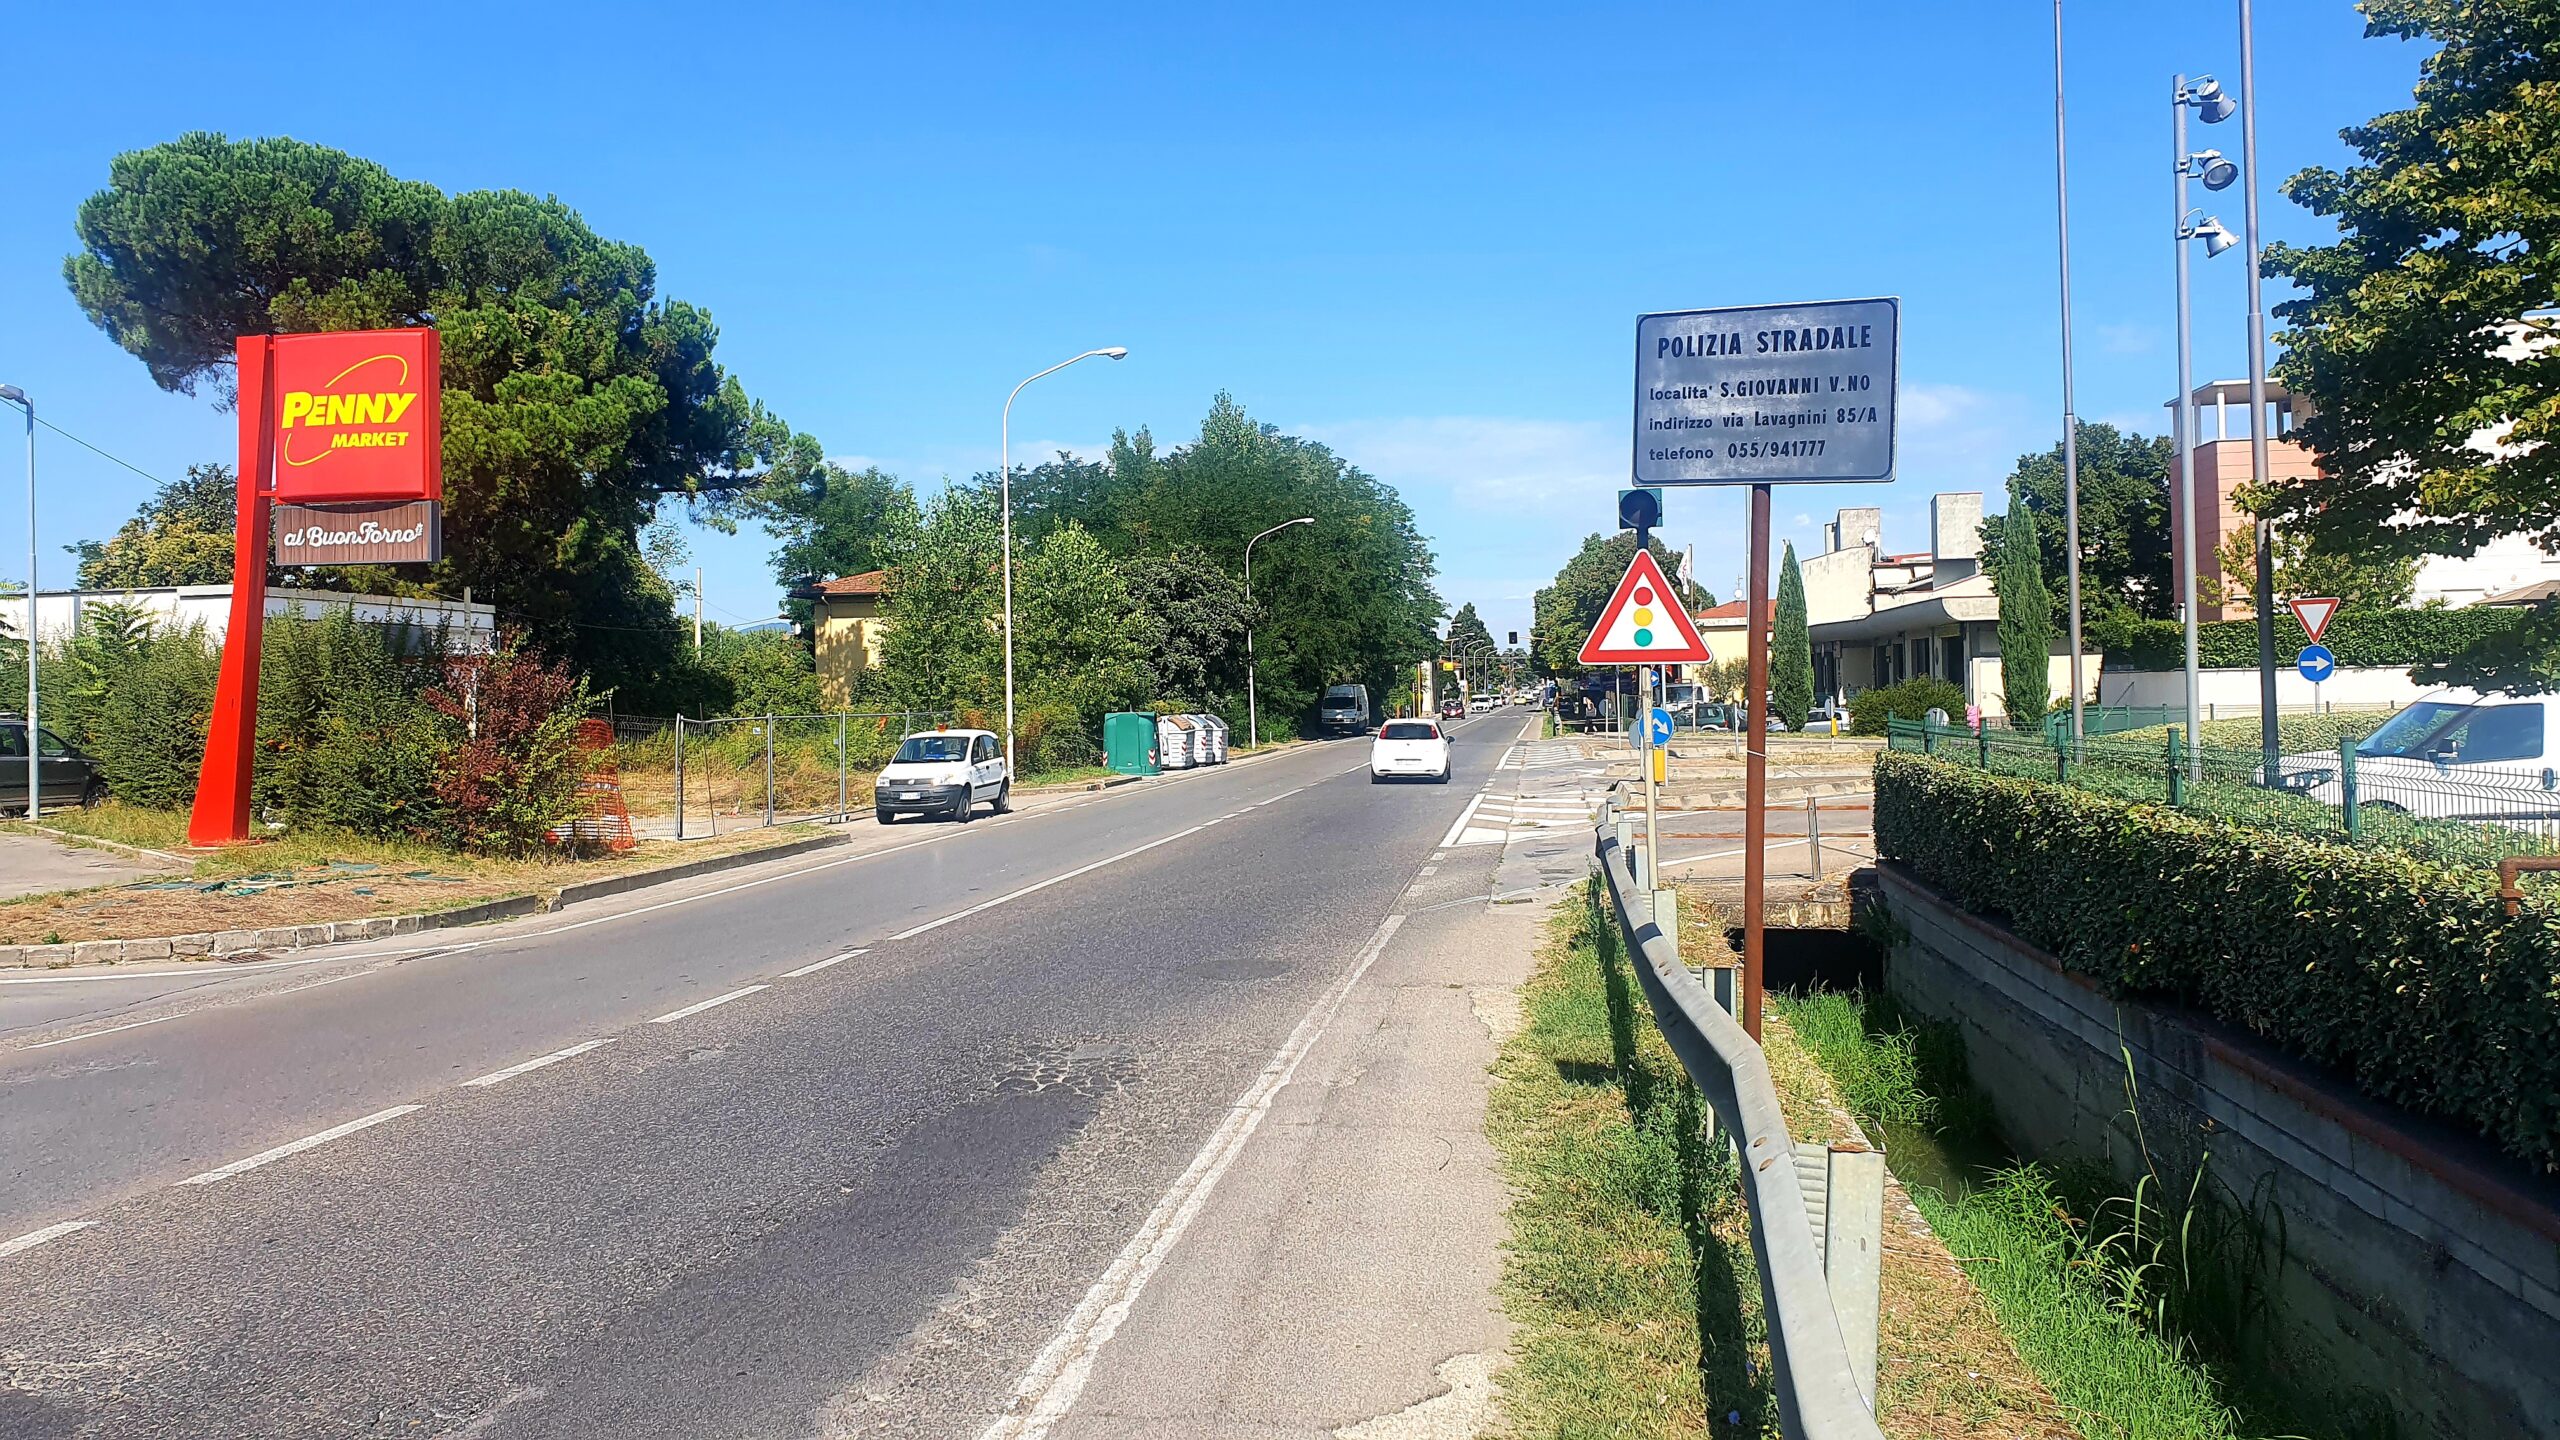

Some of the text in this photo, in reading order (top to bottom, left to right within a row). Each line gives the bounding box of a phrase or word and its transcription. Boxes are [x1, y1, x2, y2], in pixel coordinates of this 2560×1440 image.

[1658, 325, 1871, 358] POLIZIA STRADALE
[1650, 375, 1870, 401] localita' S.GIOVANNI V.NO
[282, 391, 417, 429] PENNY
[1649, 407, 1877, 430] indirizzo via Lavagnini 85/A
[331, 432, 409, 448] MARKET
[1649, 440, 1825, 460] telefono 055/941777
[284, 529, 304, 546] al
